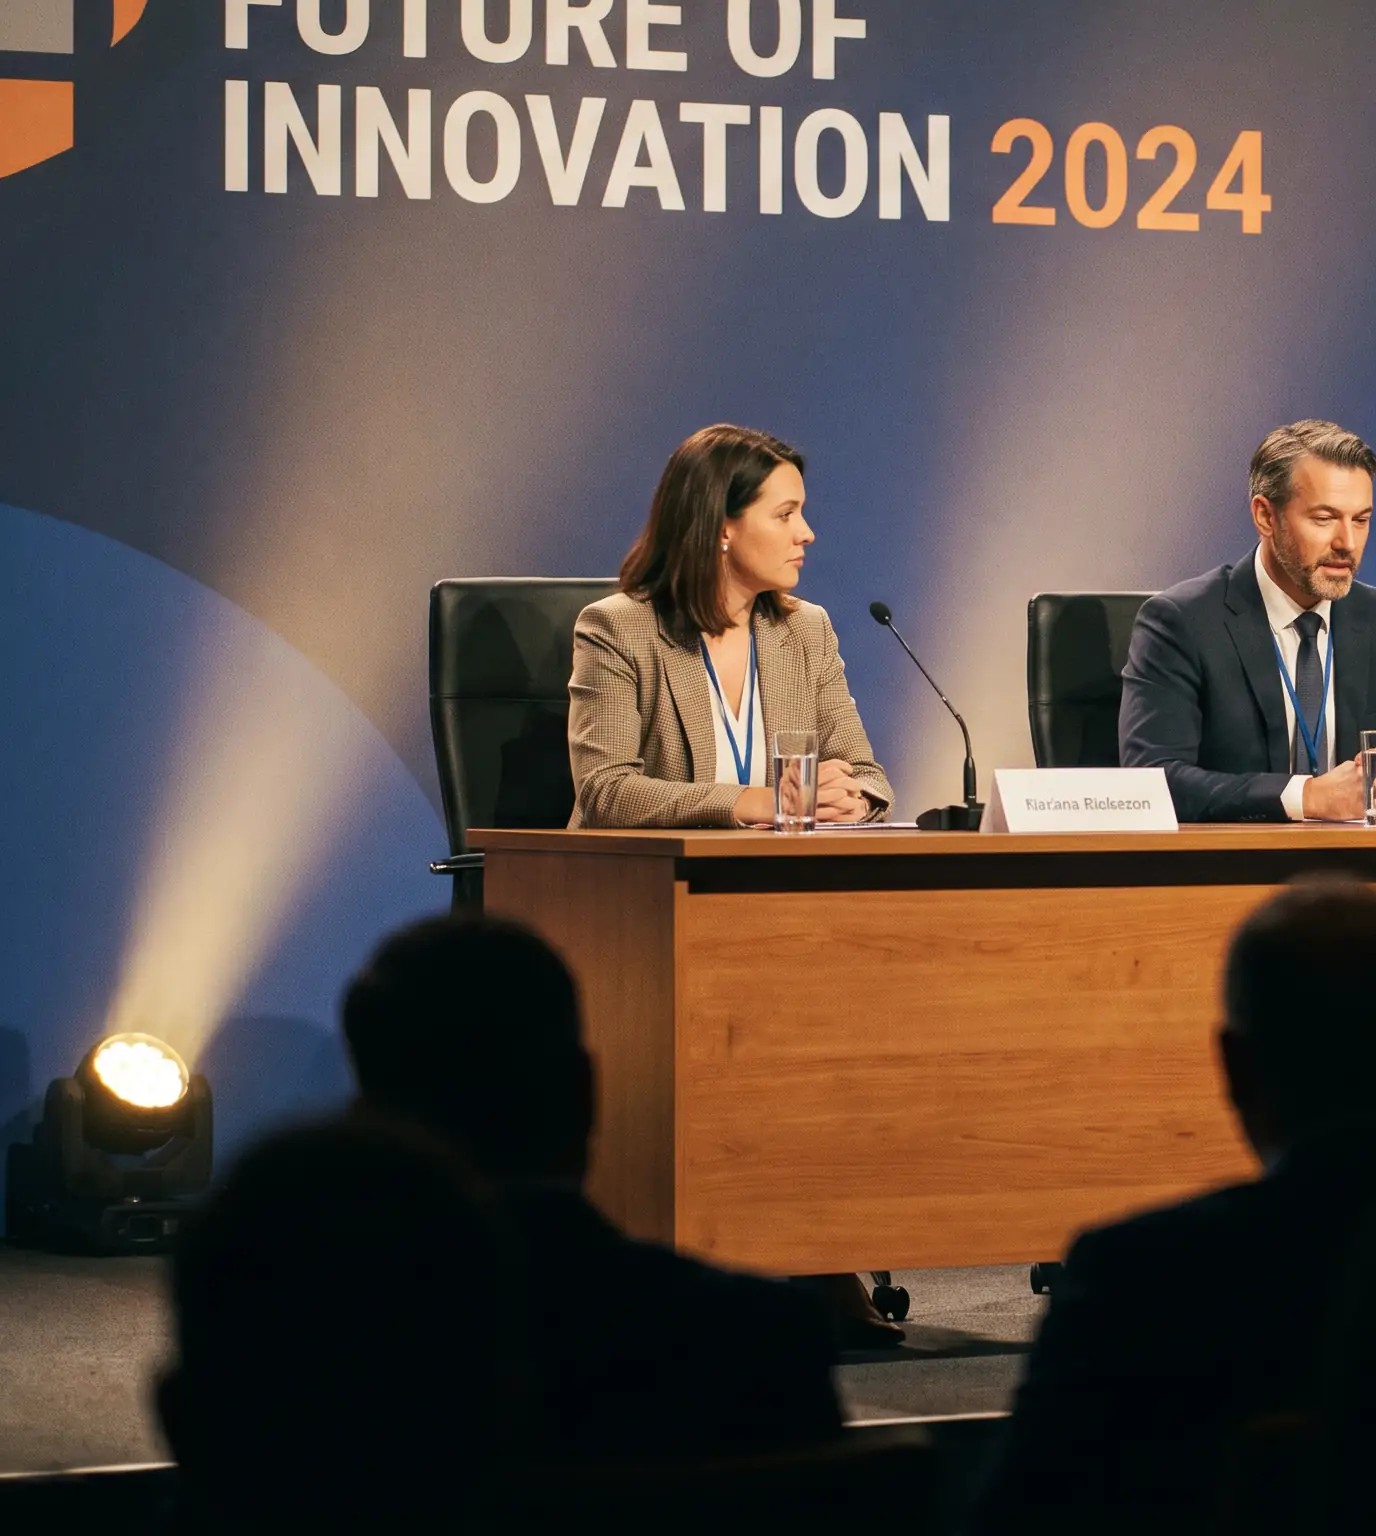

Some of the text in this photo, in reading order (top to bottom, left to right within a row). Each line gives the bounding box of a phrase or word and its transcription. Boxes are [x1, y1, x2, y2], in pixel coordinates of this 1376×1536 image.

[727, 0, 867, 80] OF
[225, 80, 1273, 235] INNOVATION 2024
